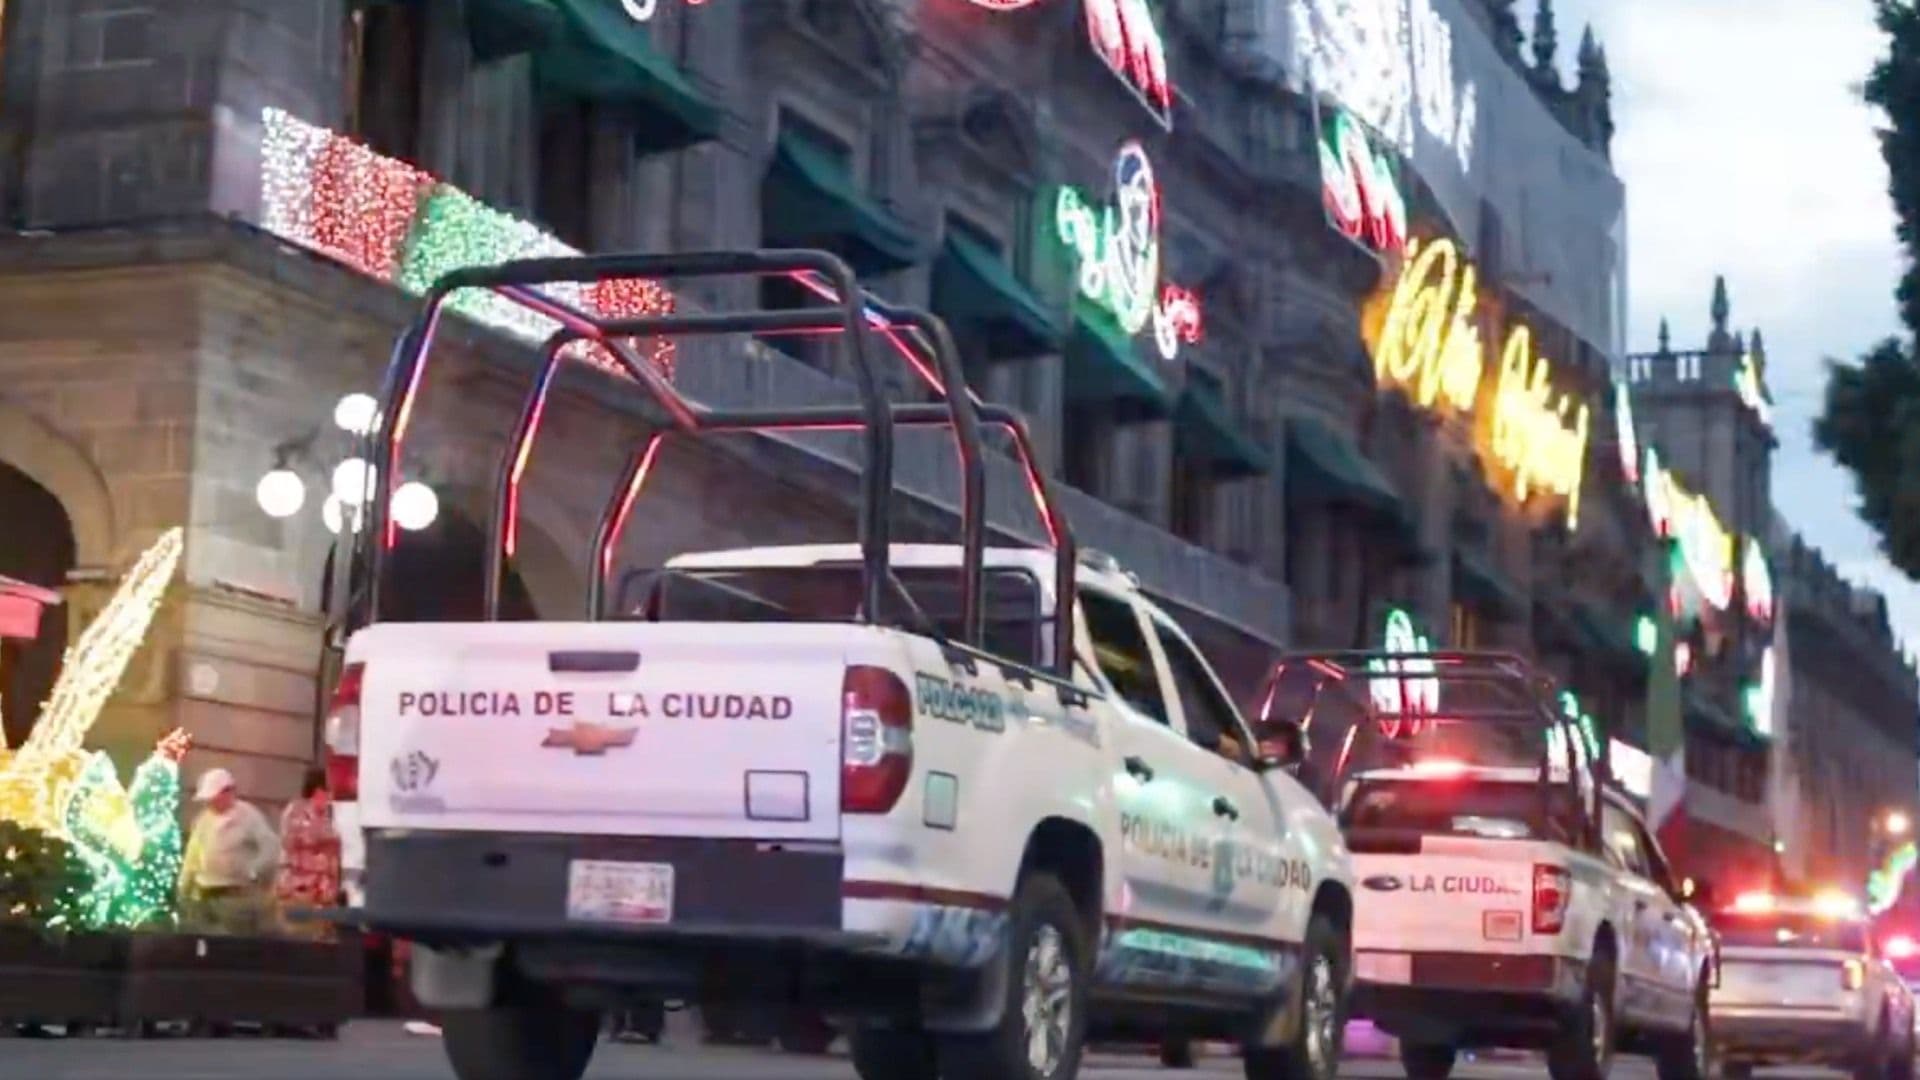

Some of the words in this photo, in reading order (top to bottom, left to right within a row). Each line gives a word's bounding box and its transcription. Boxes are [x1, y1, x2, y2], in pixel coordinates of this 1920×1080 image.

[398, 691, 521, 717] POLICIA
[534, 691, 574, 716] DE
[608, 692, 649, 717] LA
[661, 693, 793, 721] CIUDAD
[1410, 875, 1436, 893] LA
[1442, 876, 1522, 896] CIUD
